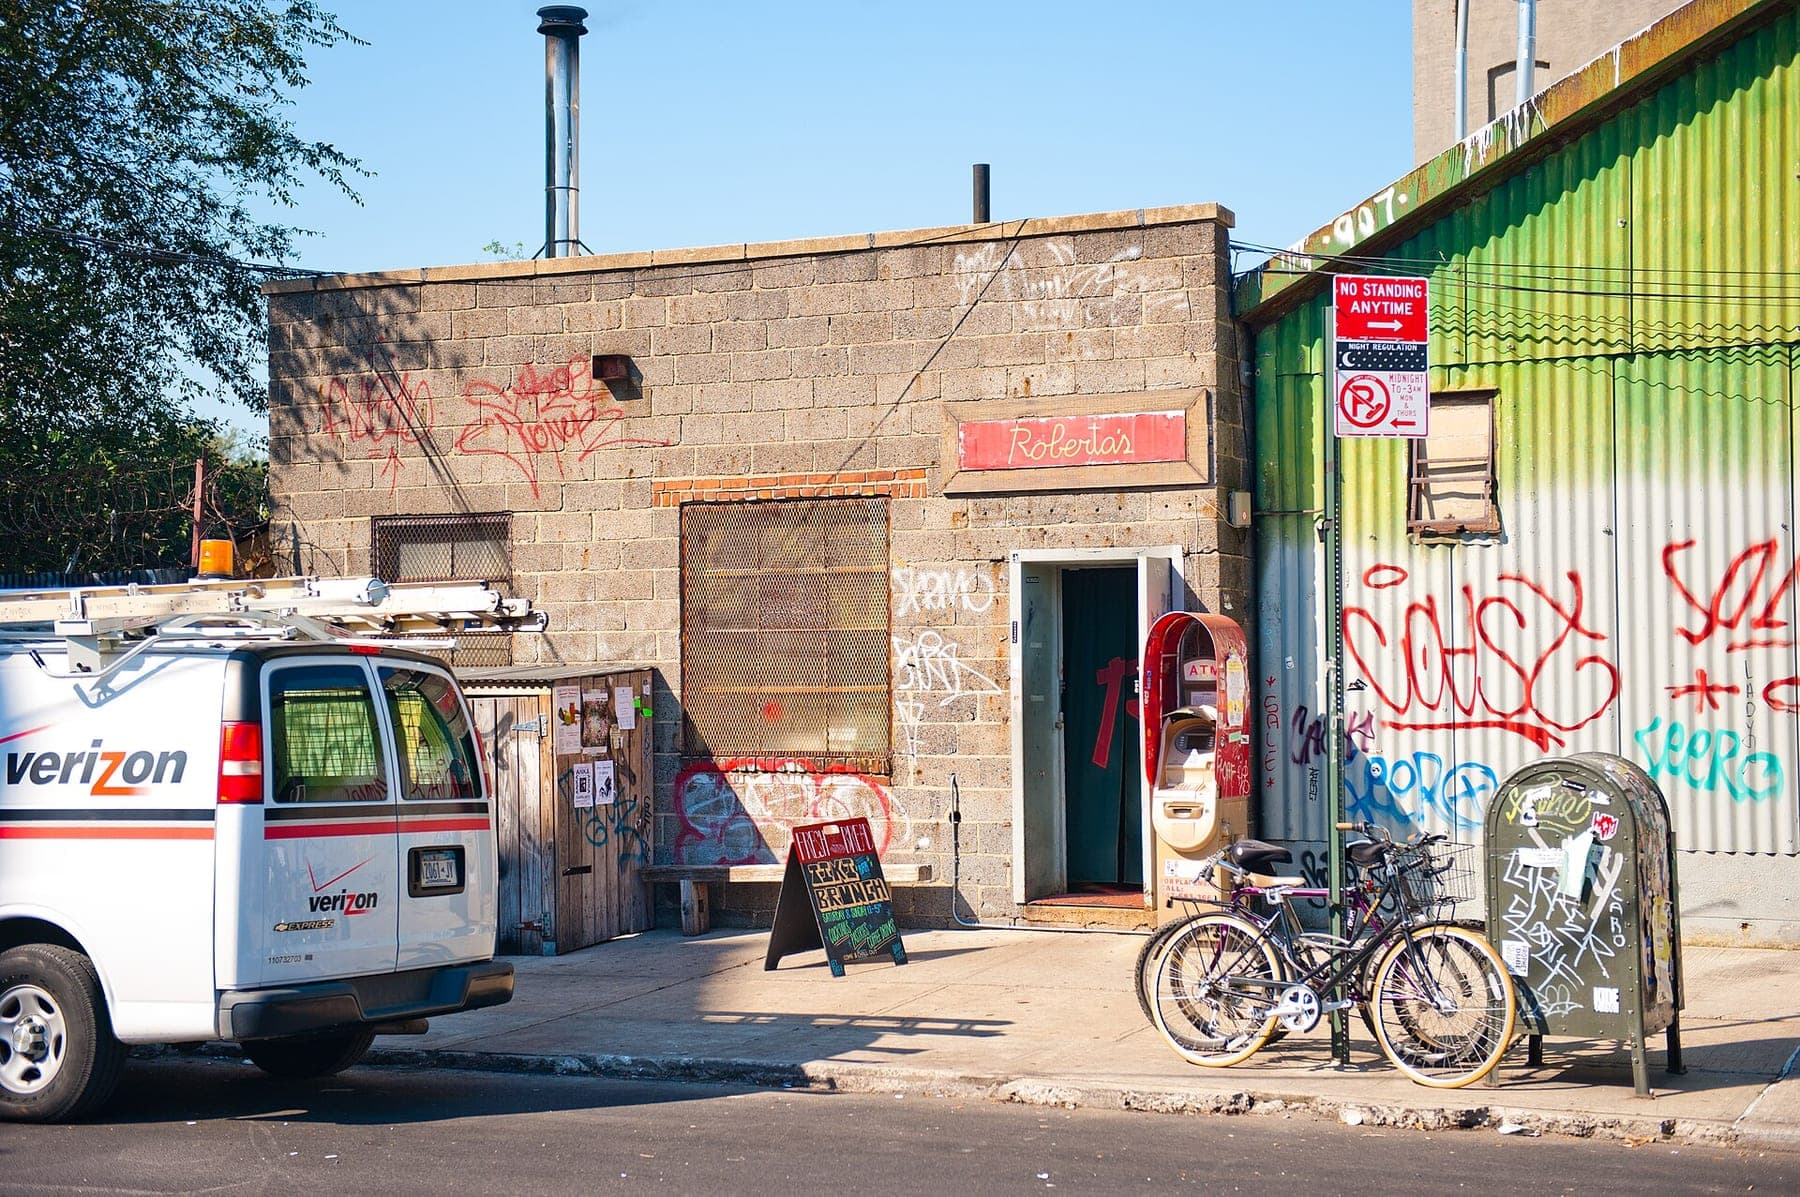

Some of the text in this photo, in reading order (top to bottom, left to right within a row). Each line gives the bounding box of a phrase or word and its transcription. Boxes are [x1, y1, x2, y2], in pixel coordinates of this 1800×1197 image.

[1340, 282, 1422, 298] NO STANDING
[1350, 301, 1414, 316] ANYTIME
[1372, 343, 1418, 351] REGULATION
[1389, 373, 1424, 383] MIDNIGHT
[1396, 409, 1417, 417] THURS
[1008, 422, 1134, 464] Roberta's
[6, 740, 188, 797] verizon
[795, 823, 874, 861] FRESH BREAD
[807, 857, 861, 888] TIKI
[308, 889, 378, 916] verizon
[813, 877, 893, 913] BRUNCH
[287, 919, 335, 931] EXPRESS
